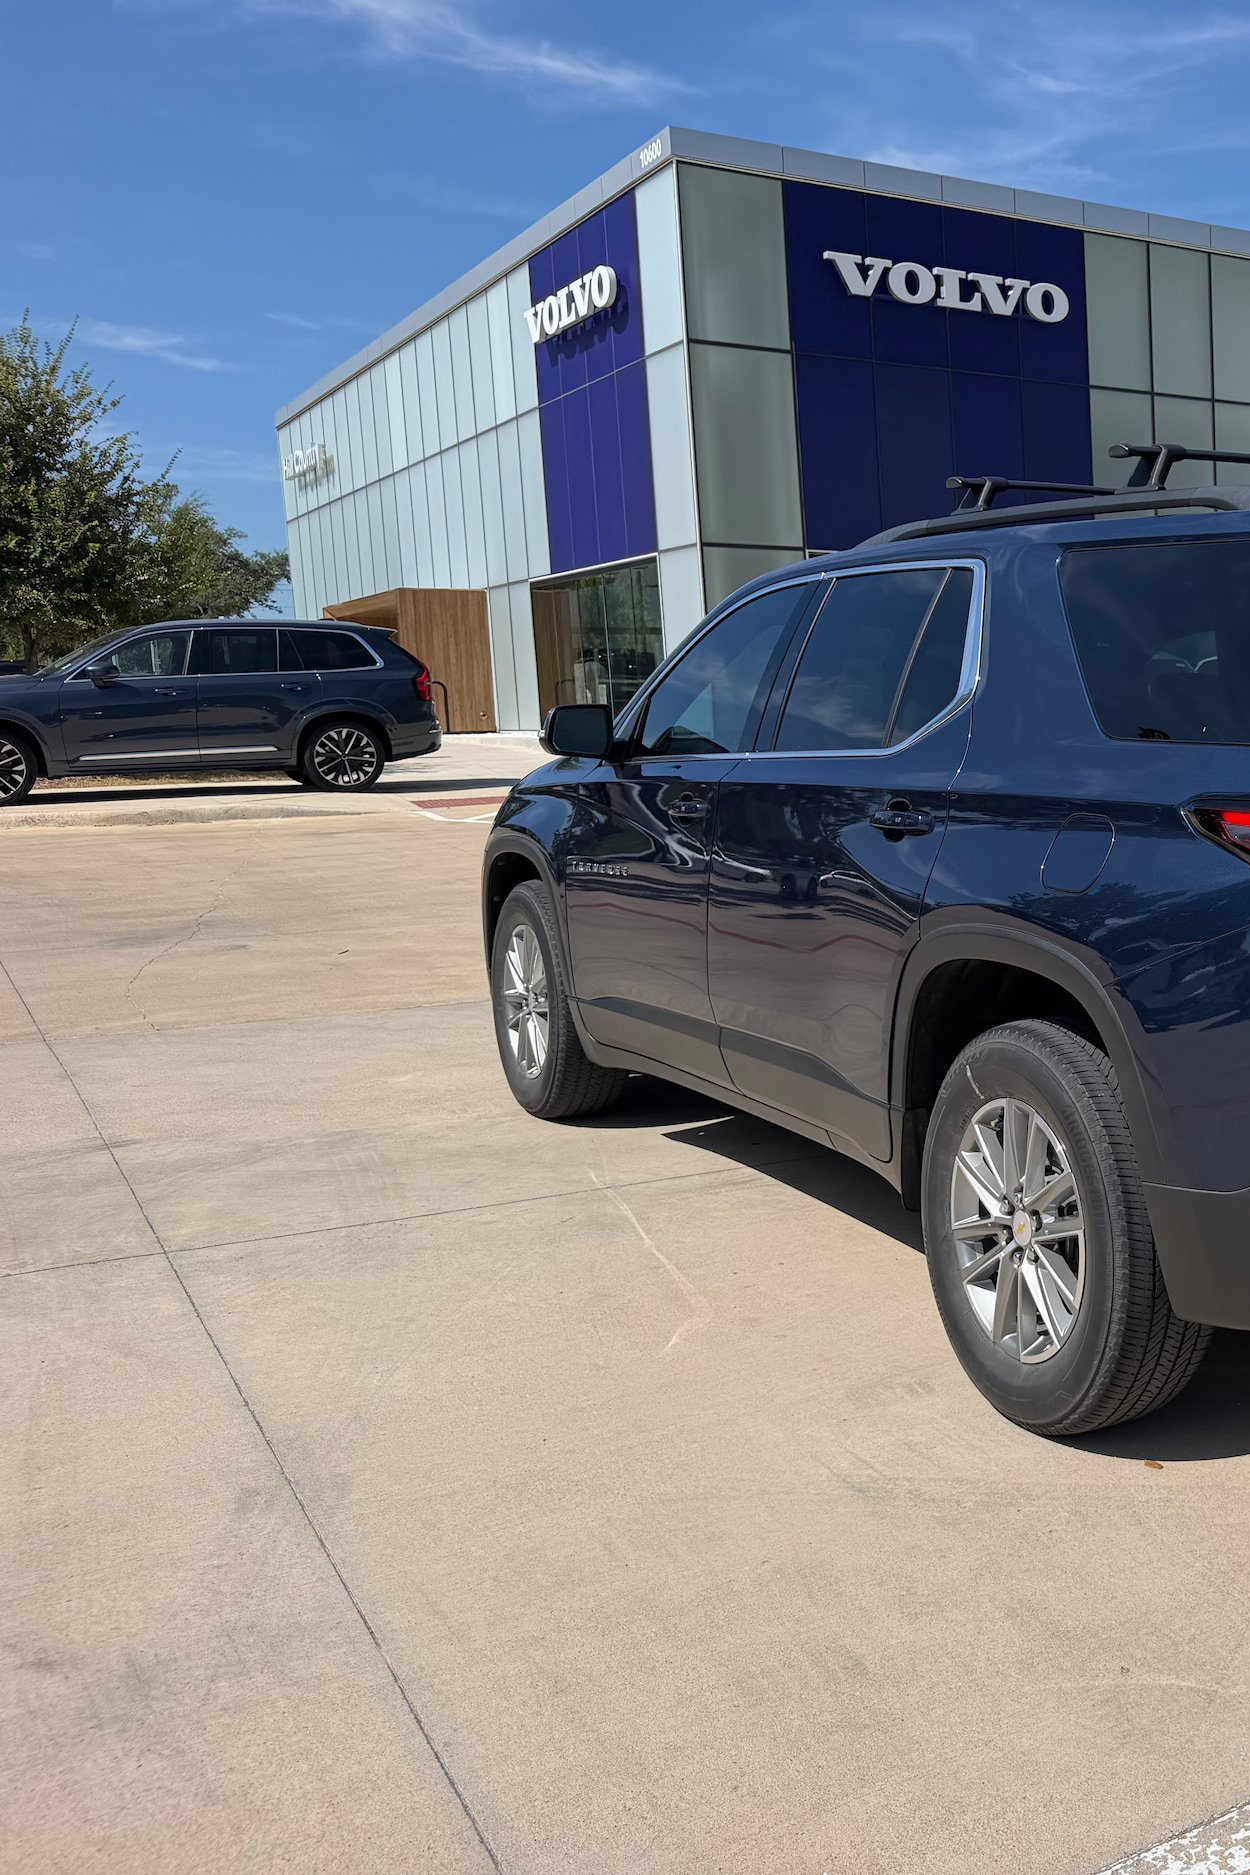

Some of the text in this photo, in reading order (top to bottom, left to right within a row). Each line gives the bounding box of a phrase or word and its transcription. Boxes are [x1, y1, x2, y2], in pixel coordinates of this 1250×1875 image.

[640, 138, 661, 168] 10600
[523, 265, 617, 344] VOLVO
[823, 251, 1069, 323] VOLVO
